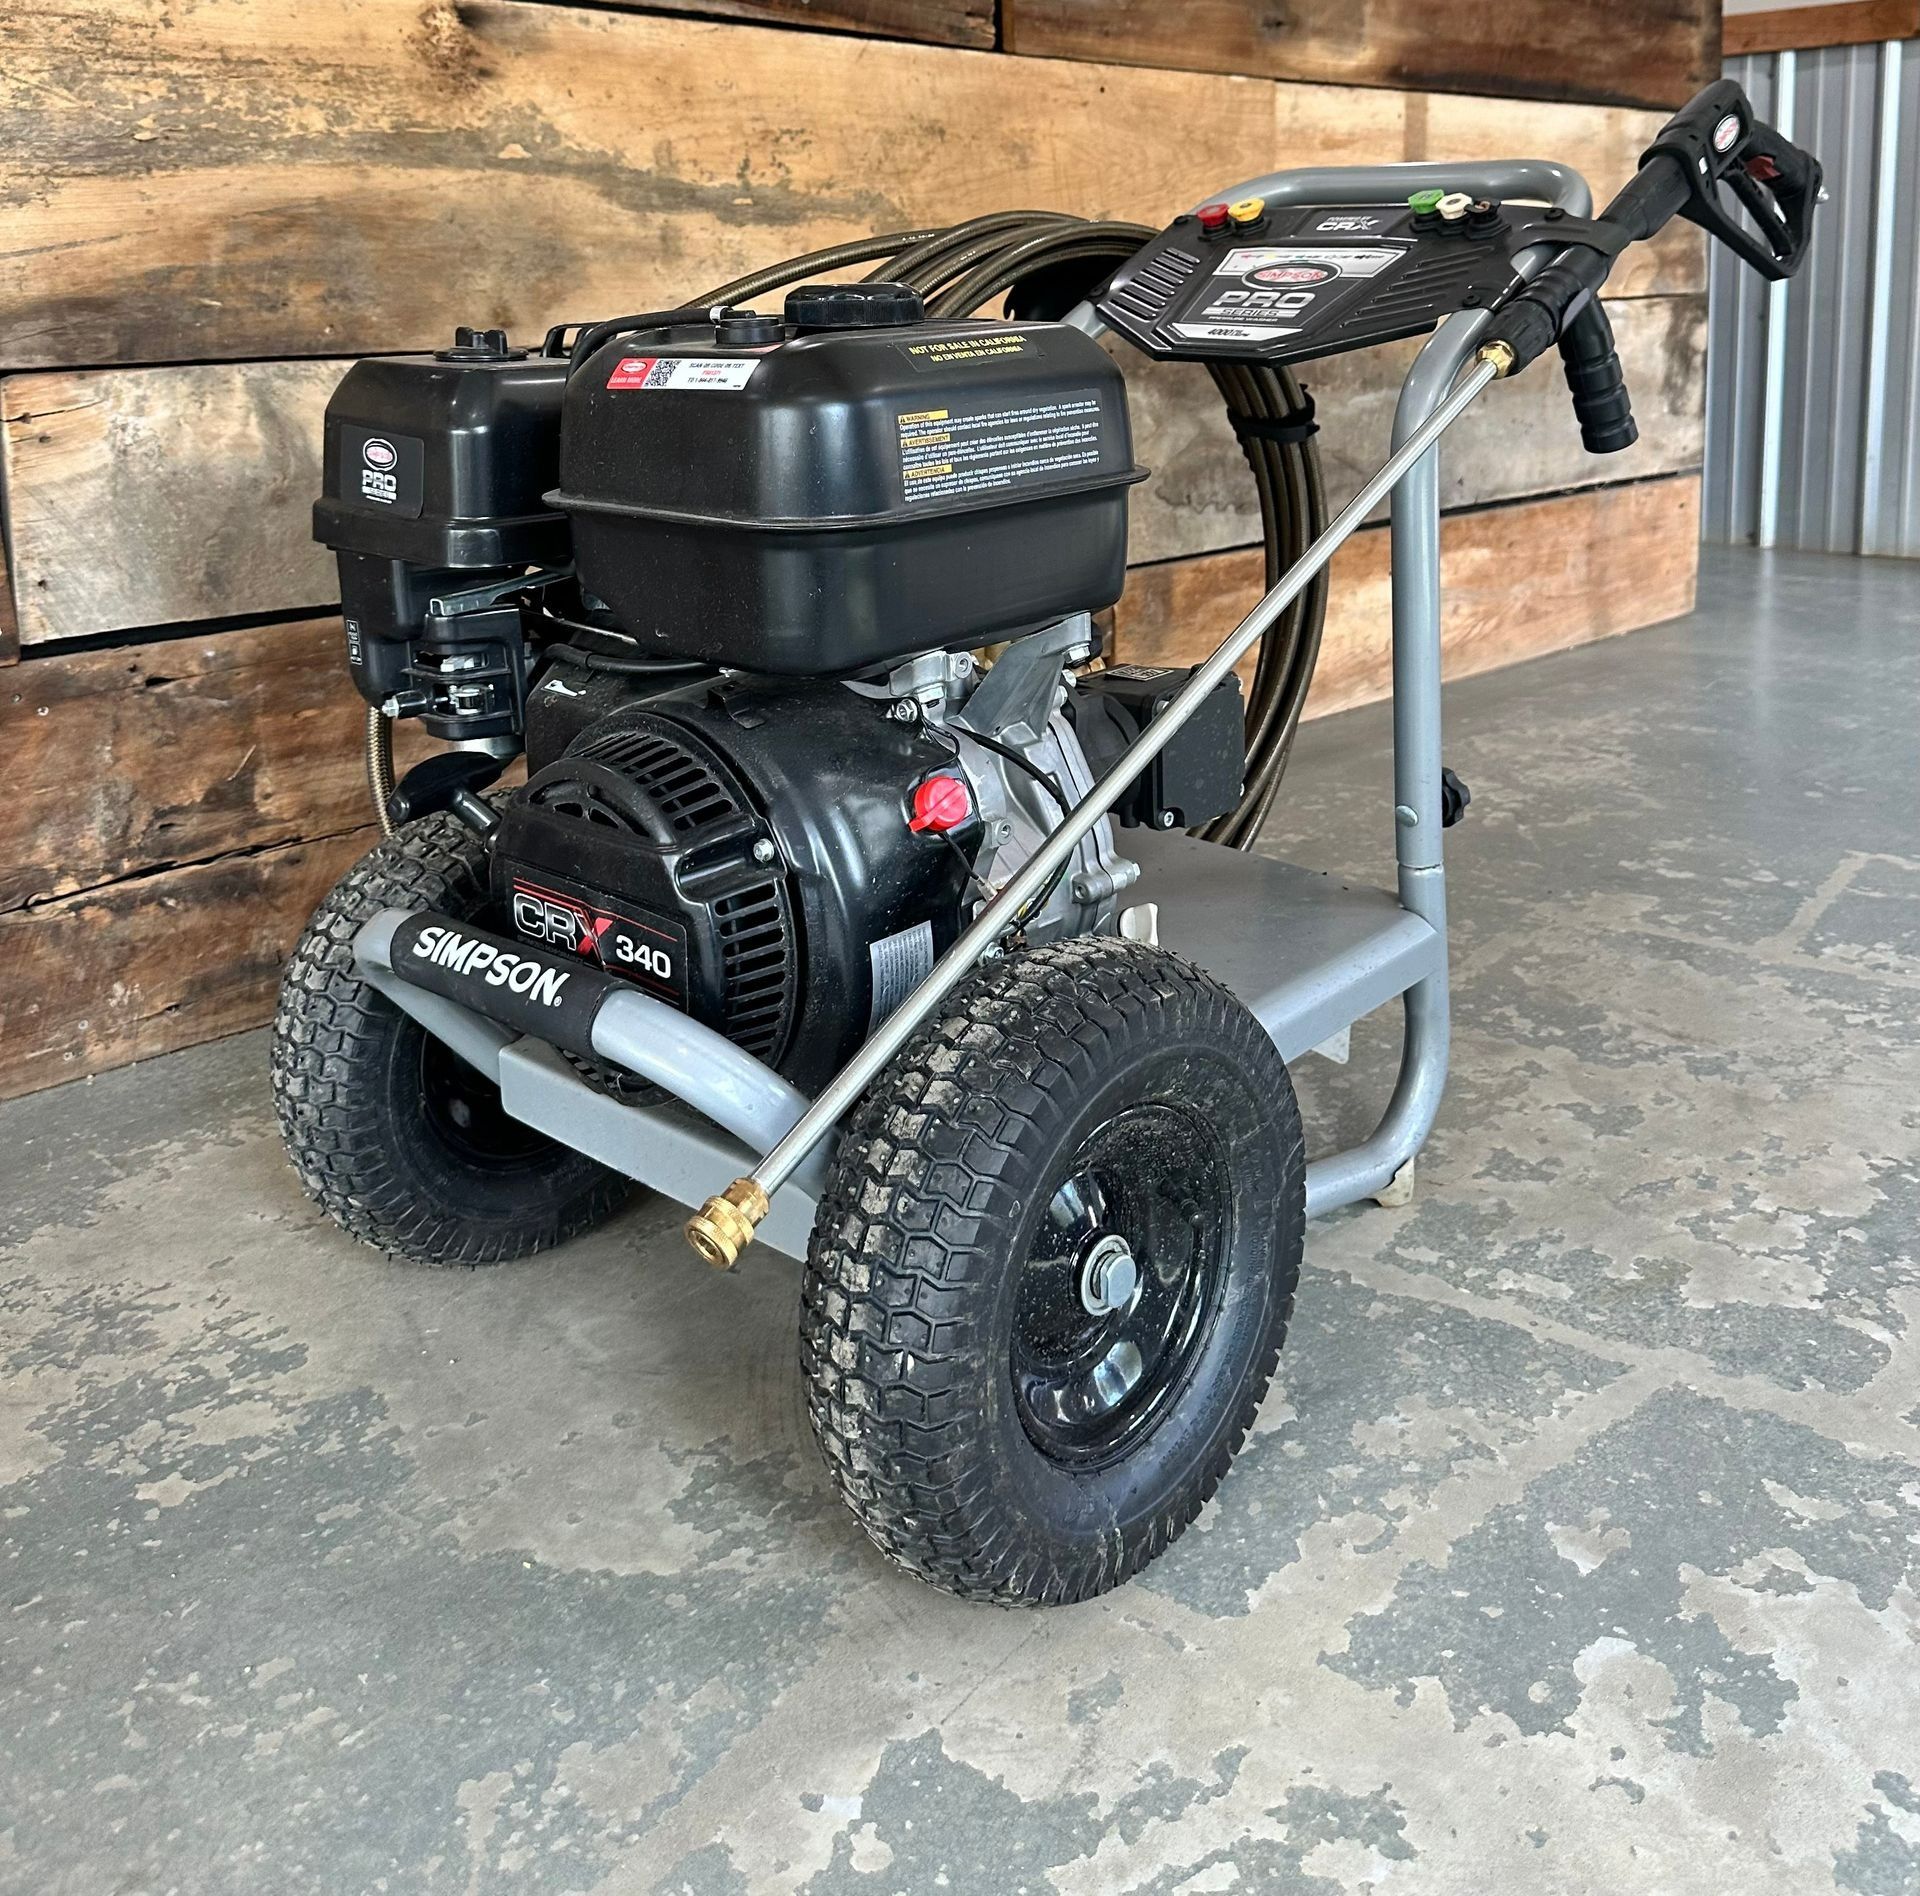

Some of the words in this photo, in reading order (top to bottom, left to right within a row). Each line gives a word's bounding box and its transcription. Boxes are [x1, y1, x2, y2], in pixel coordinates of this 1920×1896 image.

[1316, 220, 1380, 230] CRX
[1258, 268, 1324, 280] SIMPSON
[1212, 290, 1316, 308] PRO
[1221, 308, 1280, 317] SERIES
[908, 346, 929, 355] NOT
[928, 344, 948, 352] FOR
[947, 341, 970, 350] SALE
[970, 340, 981, 348] IN
[979, 335, 1027, 347] CALIFORNIA
[952, 351, 976, 359] VENTA
[986, 345, 1024, 356] CALIFORNIA
[906, 413, 930, 421] WARNING
[362, 470, 396, 492] PRO
[514, 892, 613, 955] CRX
[616, 934, 672, 979] 340
[412, 926, 570, 1006] SIMPSON
